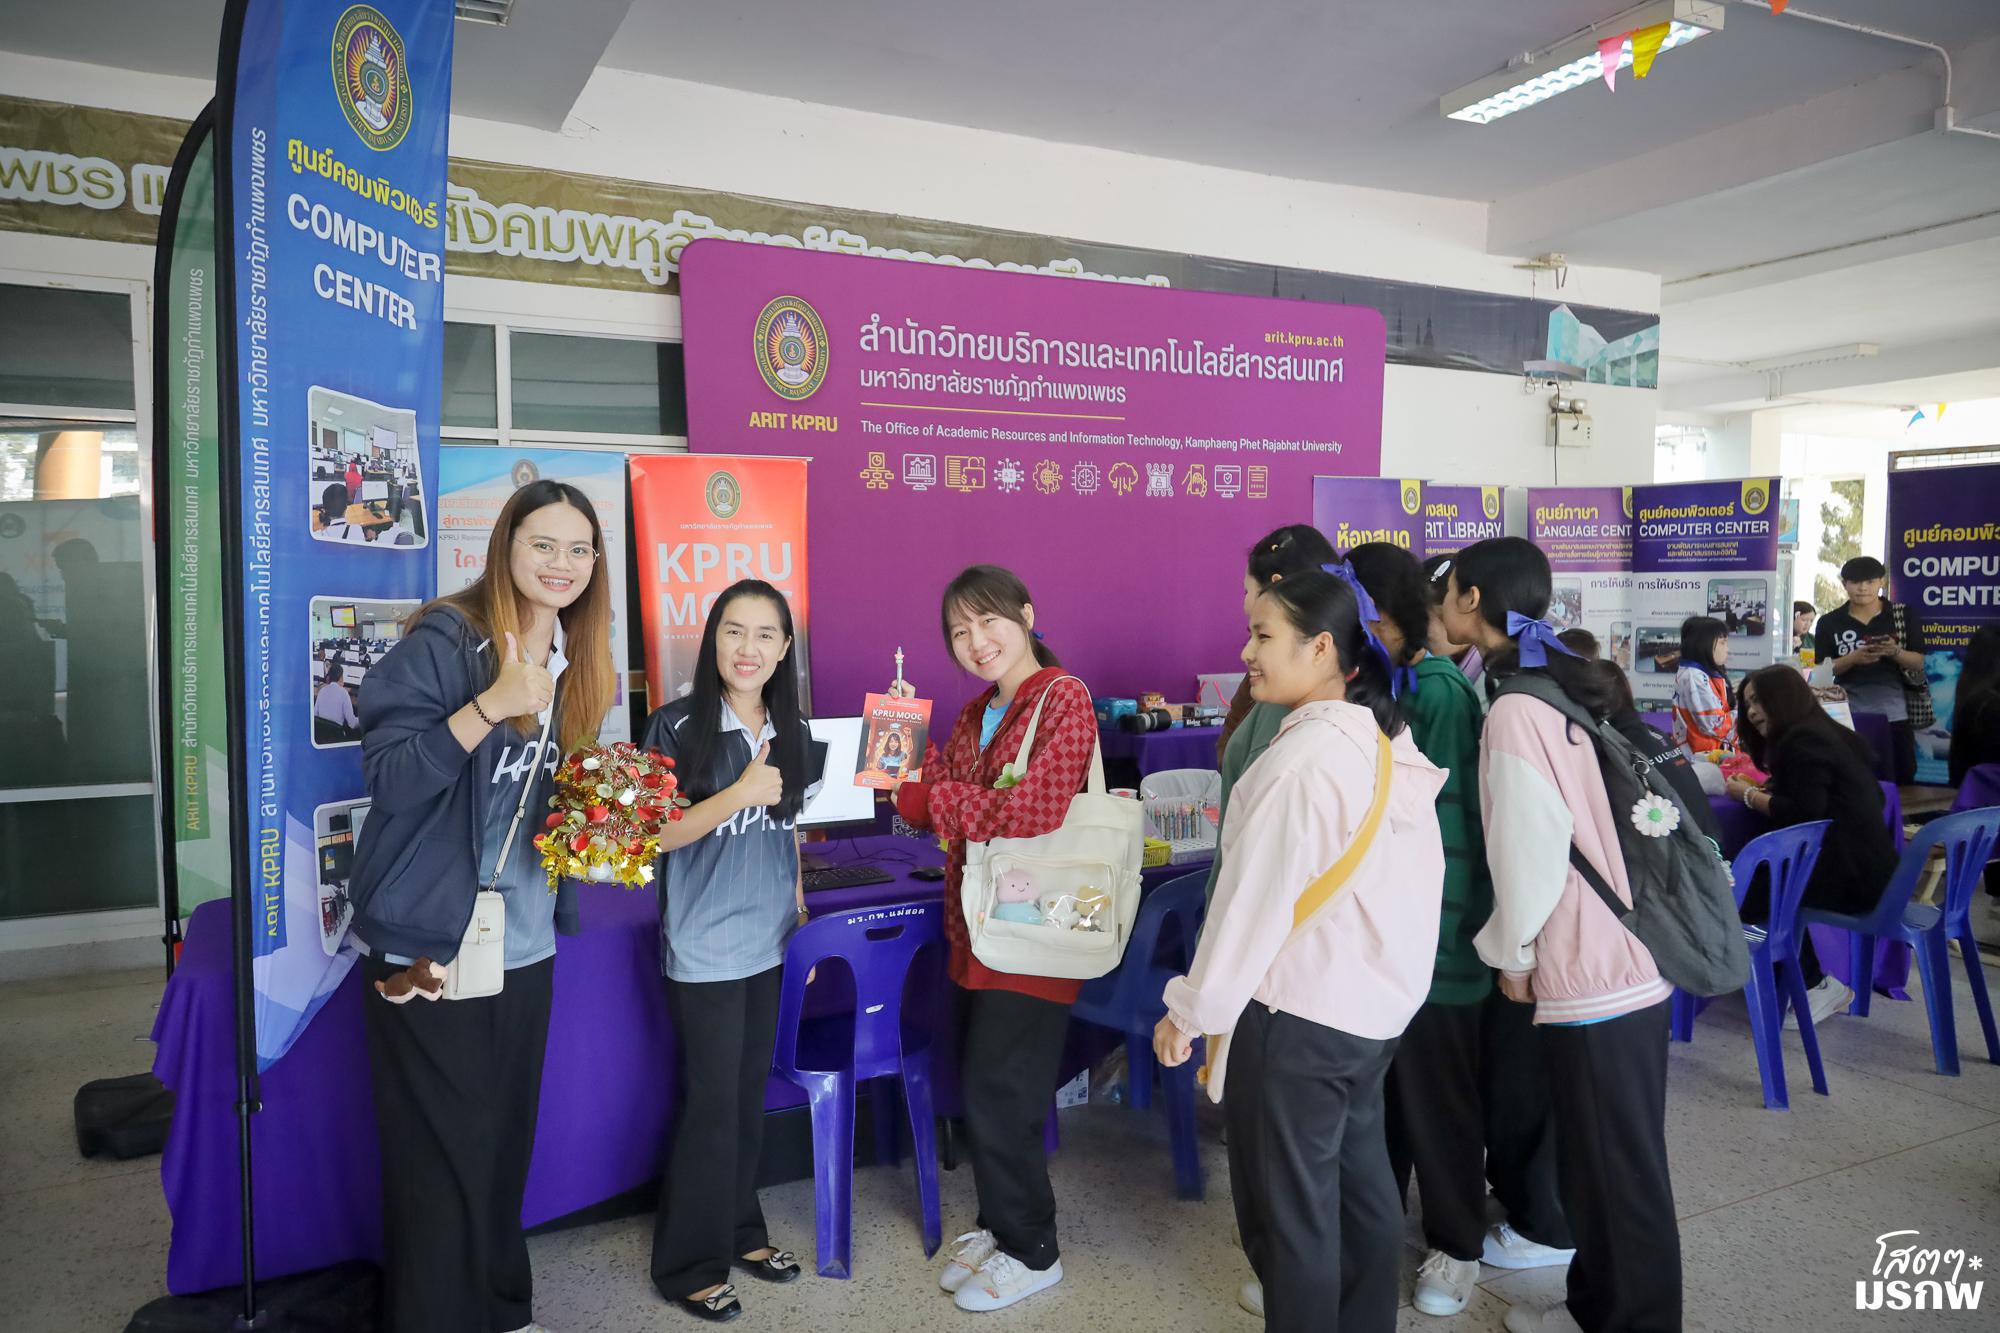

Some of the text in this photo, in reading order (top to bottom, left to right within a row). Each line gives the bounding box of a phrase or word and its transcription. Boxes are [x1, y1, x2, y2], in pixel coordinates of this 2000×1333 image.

[0, 158, 115, 200] พชร
[287, 138, 439, 229] ศูนย์คอมพิวเตอร์
[287, 193, 441, 283] COMPUTER
[313, 263, 417, 331] CENTER
[859, 313, 1344, 383] สำนักวิทยบริการและเทคโนโลยีสารสนเทศ
[1264, 331, 1344, 348] arit.kpru.ac.th
[860, 367, 1127, 403] มหาวิทยาลัยราชภัฏกำแพงเพชร
[749, 411, 838, 432] ARIT KPRU
[860, 420, 1343, 455] The Office of Academic Resources and Information Technology, Kamphaeng Phet Rajabhat University
[1425, 503, 1458, 521] งสมุด
[1536, 503, 1599, 525] ศูนย์ภาษา
[1639, 502, 1735, 523] ศูนย์คอมพิวเตอร์
[1336, 522, 1411, 549] ห้องสมด
[1425, 522, 1502, 538] RIT LIBRARY
[1536, 525, 1632, 538] LANGUAGE CENT
[1639, 520, 1770, 537] COMPUTER CENTER
[1903, 523, 2000, 549] ศูนย์คอมพิว
[657, 542, 793, 583] KPRU
[1903, 556, 1999, 578] COMPU
[1590, 578, 1633, 589] การให้บริ
[1638, 578, 1701, 590] การให้บริการ
[871, 708, 895, 718] KPRU
[896, 710, 923, 720] MOOC
[186, 755, 200, 831] ARIT KPRU
[261, 828, 281, 888] KPRU
